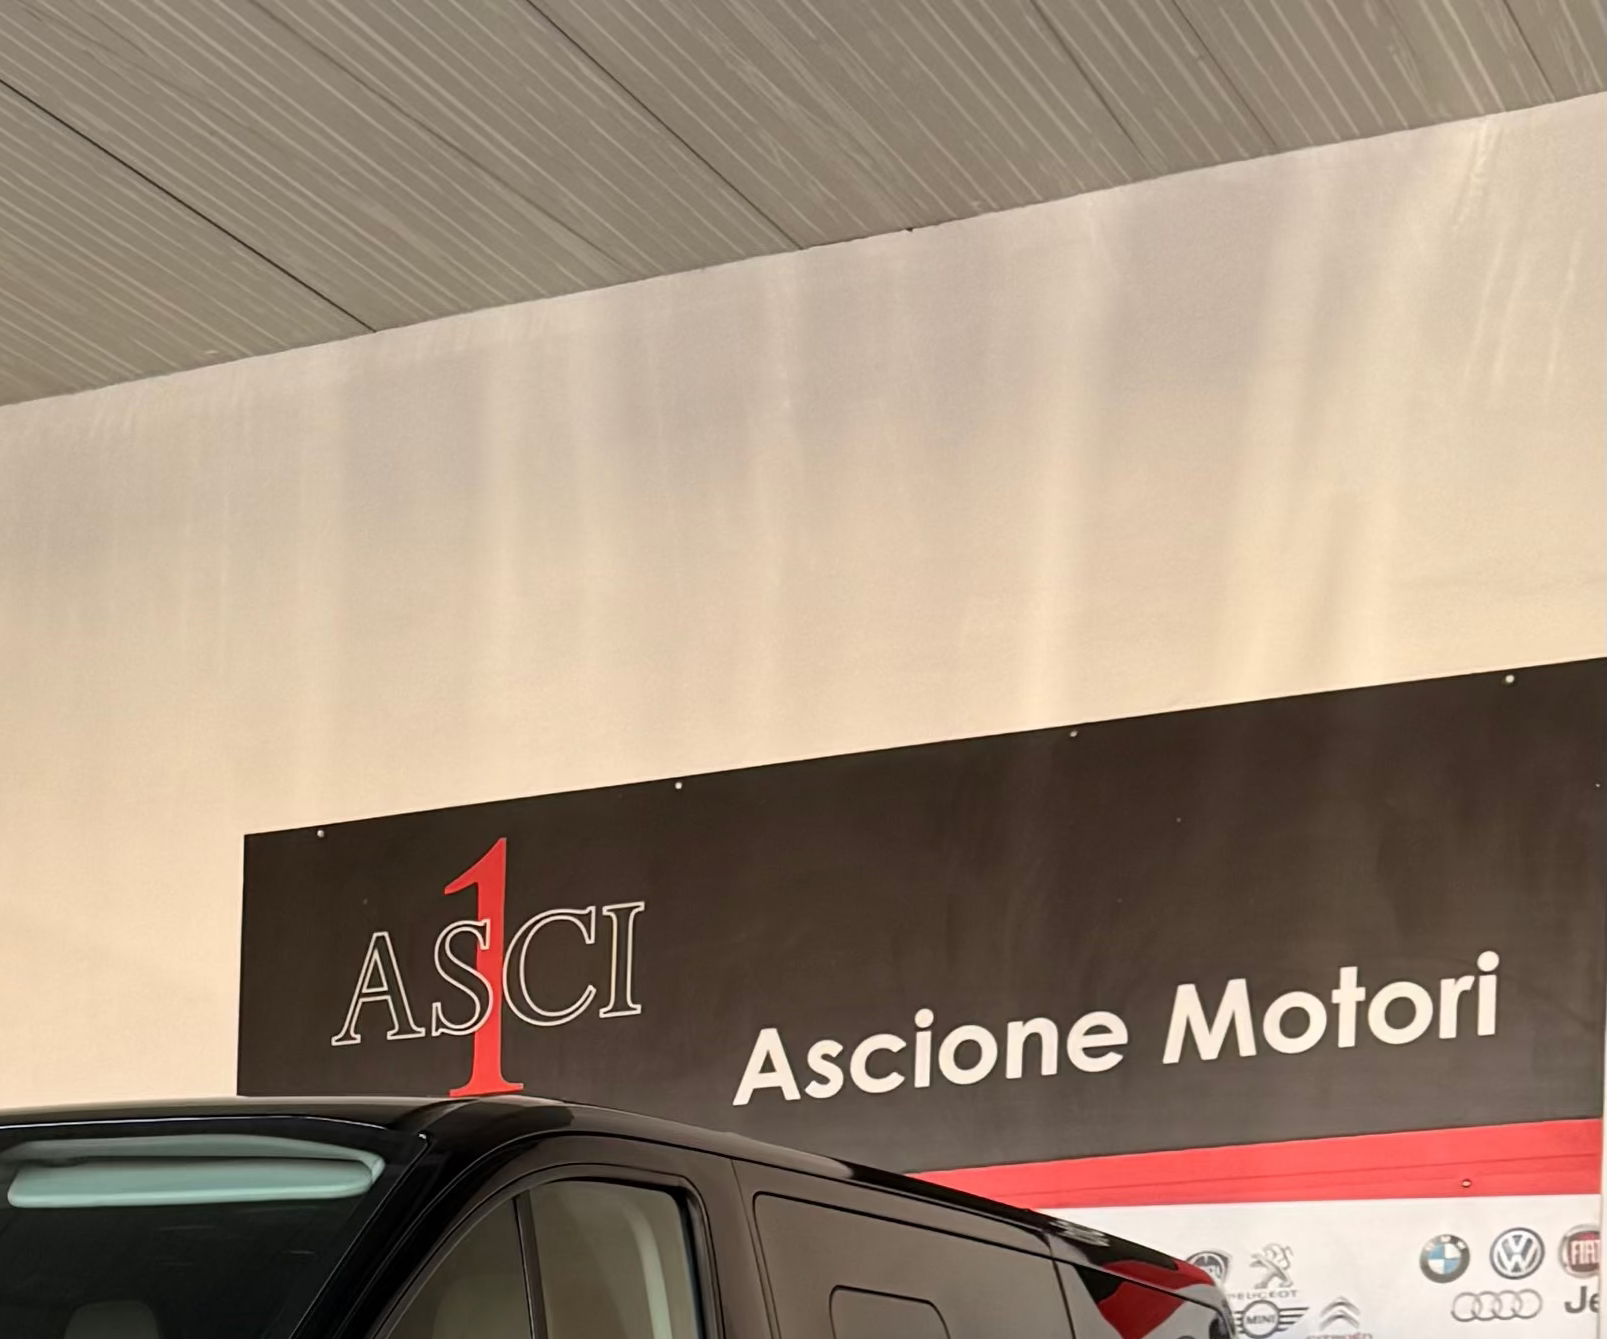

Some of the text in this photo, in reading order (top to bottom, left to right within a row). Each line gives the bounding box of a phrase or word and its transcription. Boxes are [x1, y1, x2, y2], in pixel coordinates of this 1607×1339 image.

[331, 901, 645, 1046] ASCI
[445, 838, 523, 1097] 1
[732, 951, 1500, 1106] Ascione Motori
